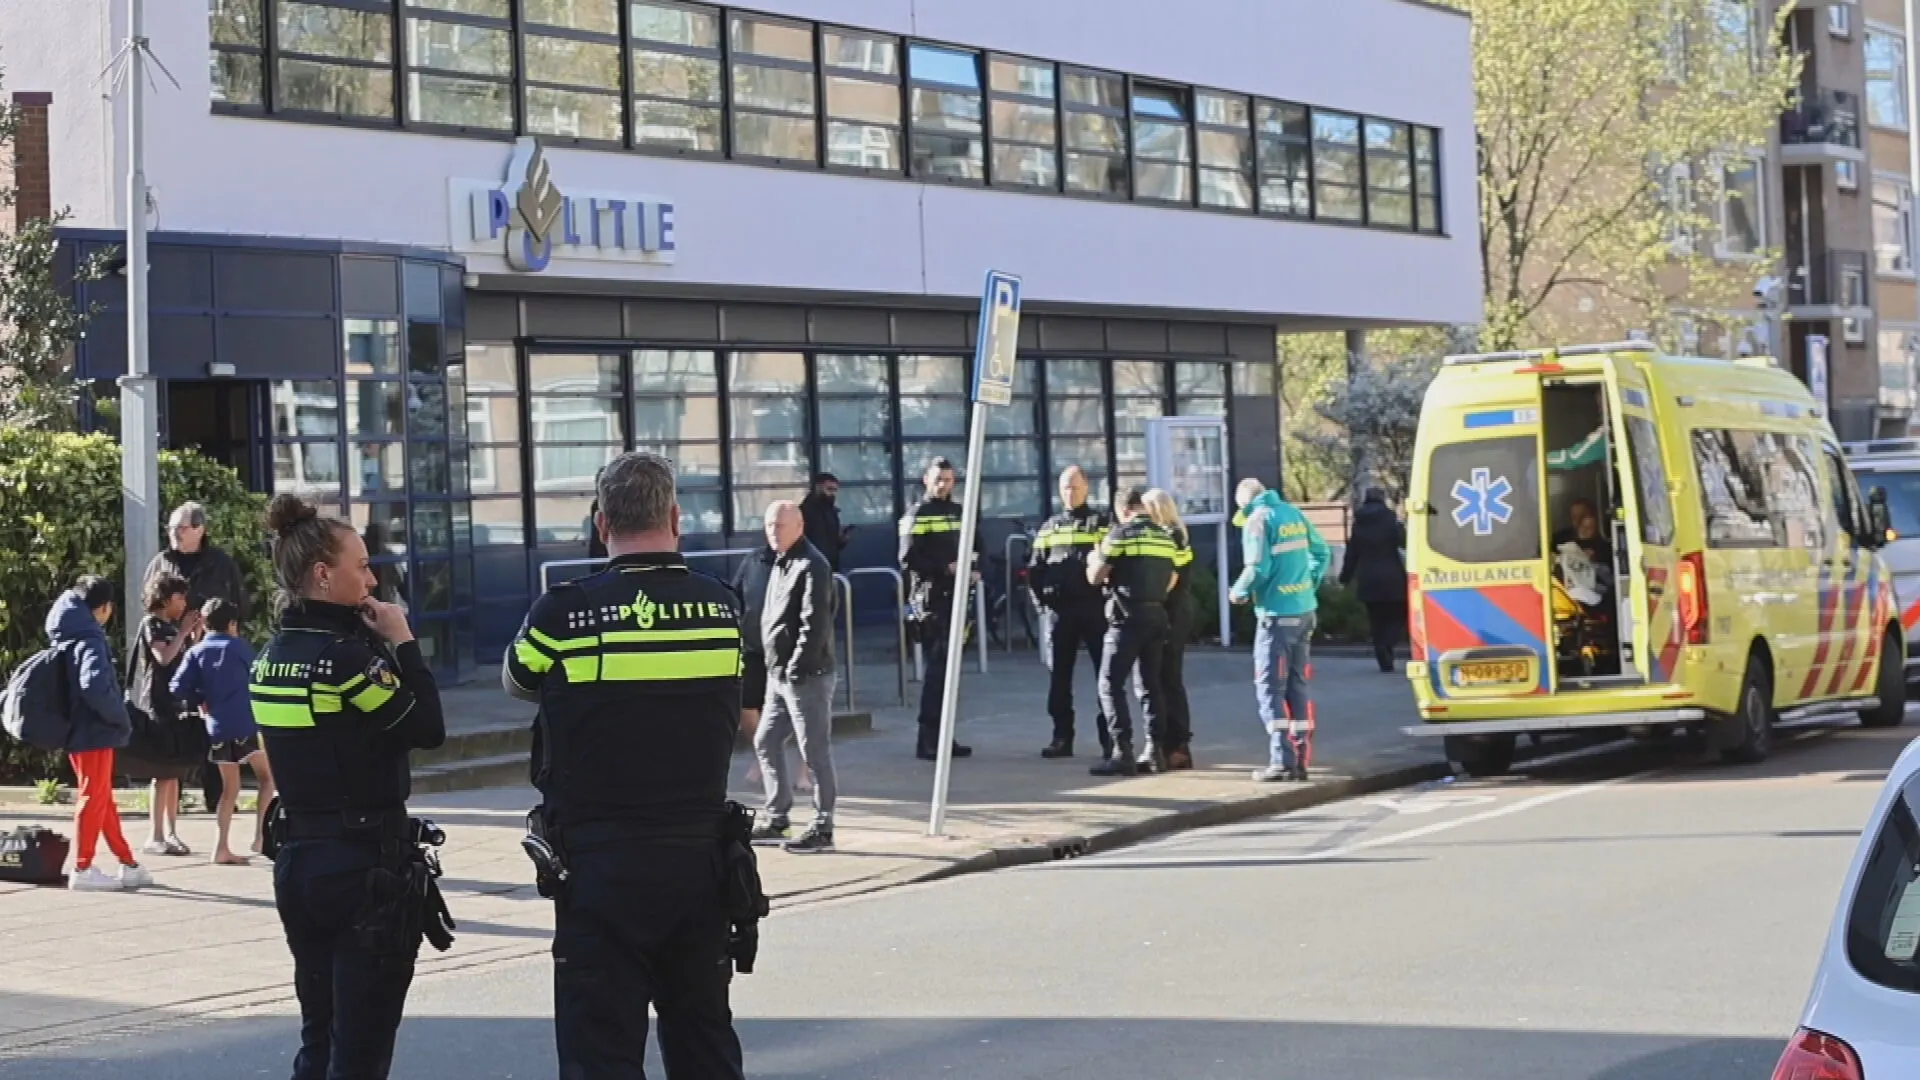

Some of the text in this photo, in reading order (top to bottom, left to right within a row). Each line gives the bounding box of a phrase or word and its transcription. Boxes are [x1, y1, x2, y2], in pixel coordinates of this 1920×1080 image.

[486, 182, 675, 272] POLITIE
[991, 281, 1014, 337] P
[1423, 565, 1533, 583] AMBULANCE
[618, 598, 720, 629] POLITIE
